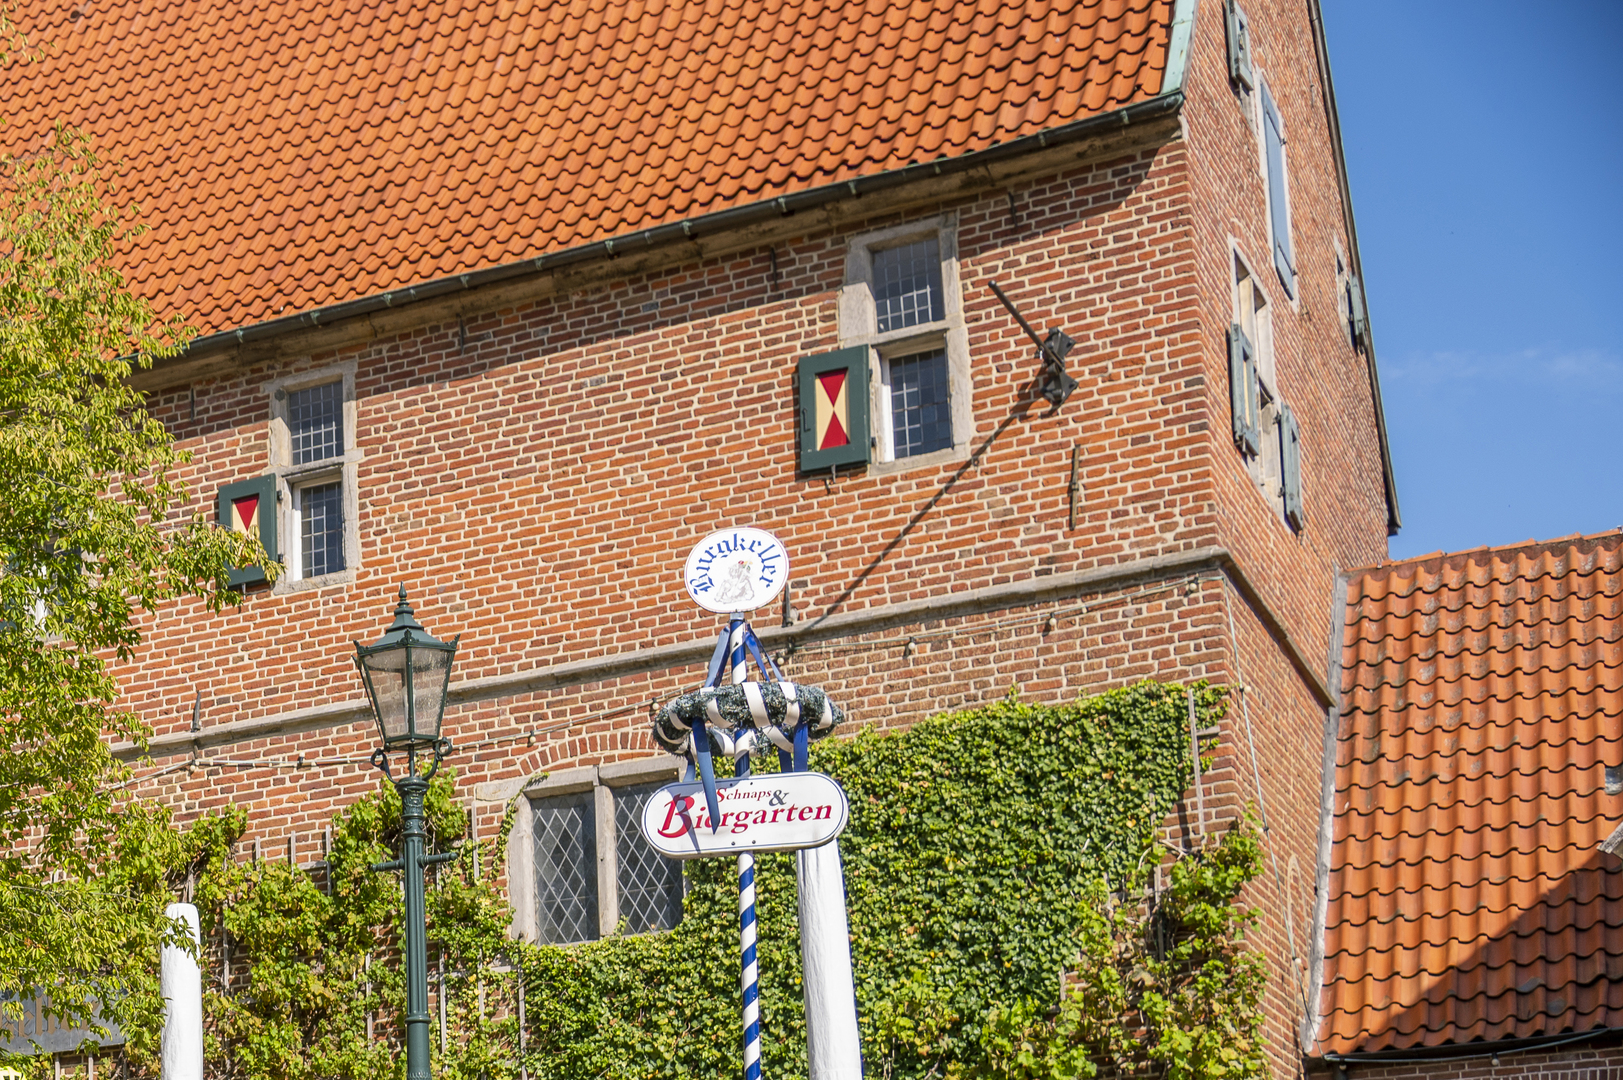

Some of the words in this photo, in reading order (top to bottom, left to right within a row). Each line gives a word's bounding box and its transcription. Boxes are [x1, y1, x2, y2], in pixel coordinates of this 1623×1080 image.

[689, 533, 781, 595] Burgkeller
[716, 787, 772, 802] Schnaps
[769, 789, 790, 806] &
